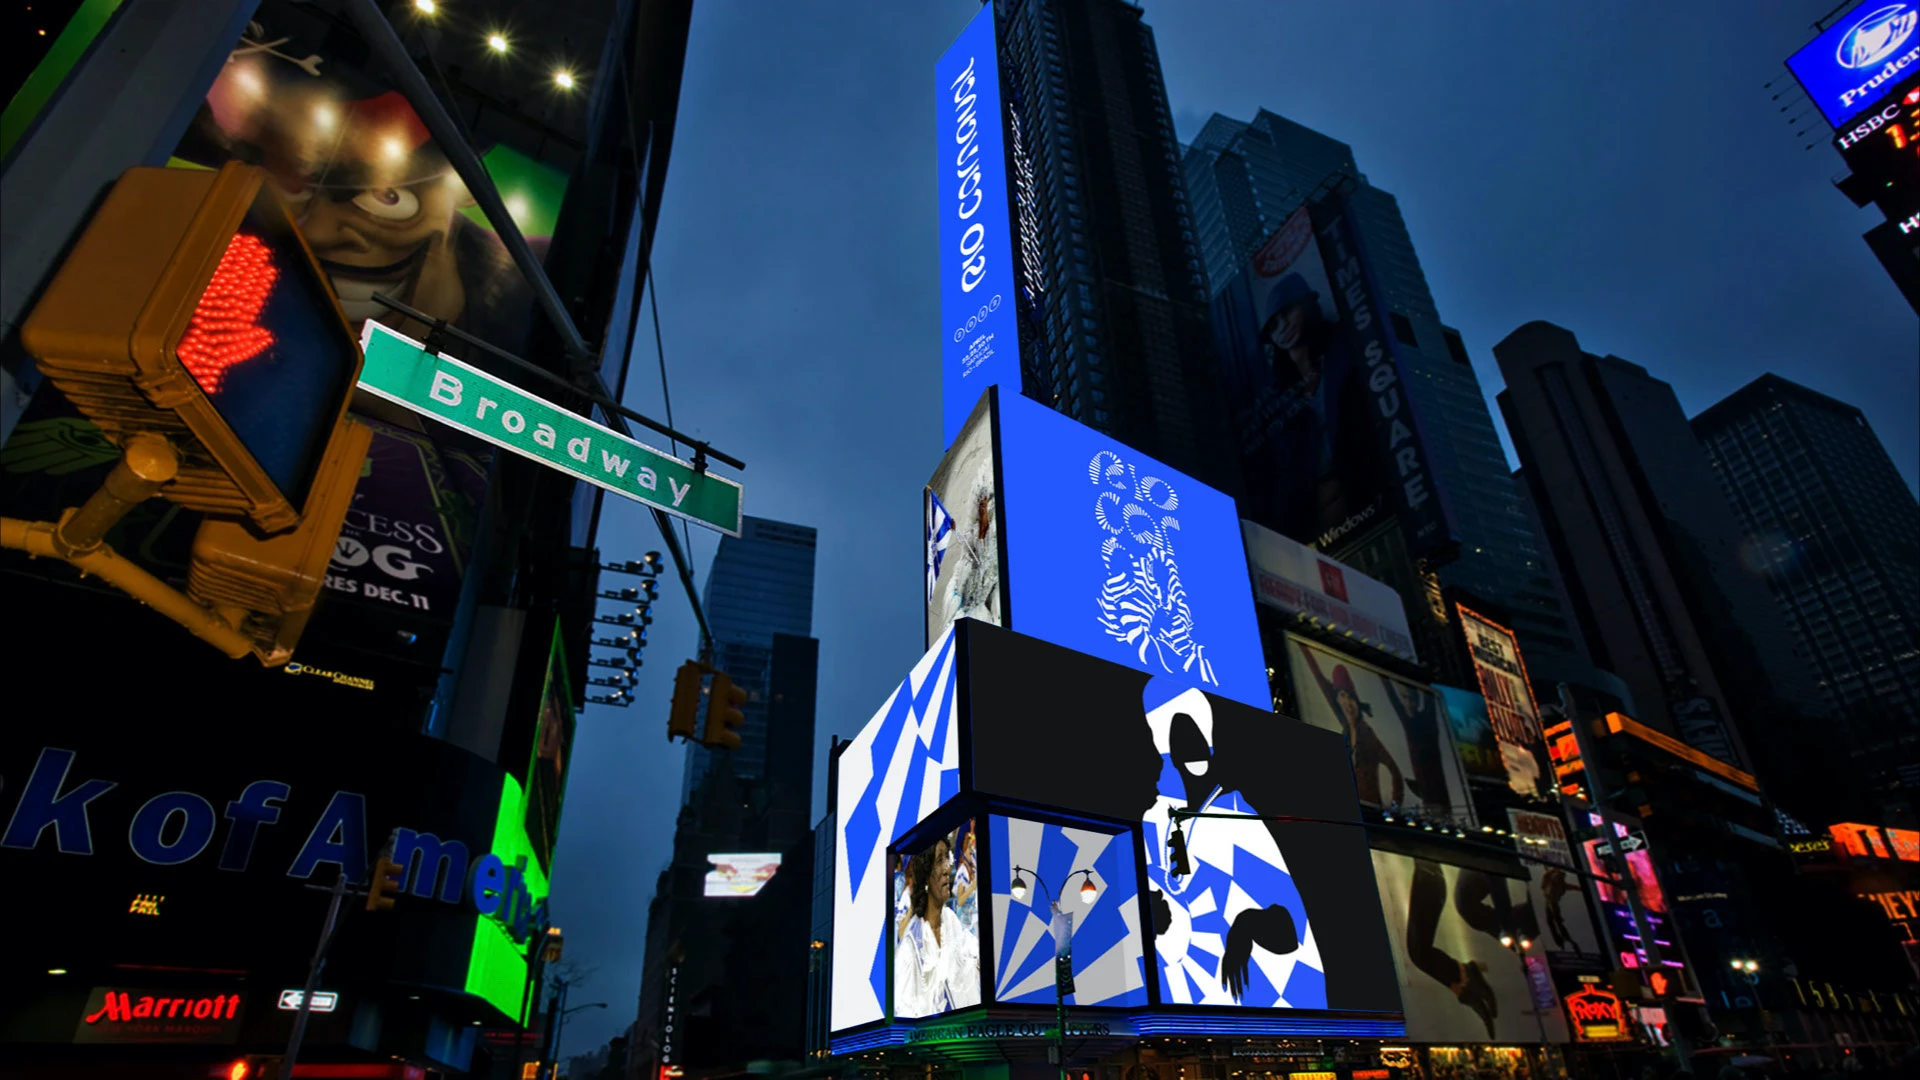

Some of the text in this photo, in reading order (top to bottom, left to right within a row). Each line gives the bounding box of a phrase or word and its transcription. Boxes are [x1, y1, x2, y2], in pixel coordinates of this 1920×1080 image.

[1838, 103, 1900, 150] HSBC
[1320, 212, 1430, 510] TIMES SQUARE
[429, 369, 691, 507] Broadway
[1318, 502, 1376, 550] Windows
[128, 779, 292, 873] of
[85, 990, 242, 1024] Marriott
[967, 1023, 1016, 1038] EAGLE
